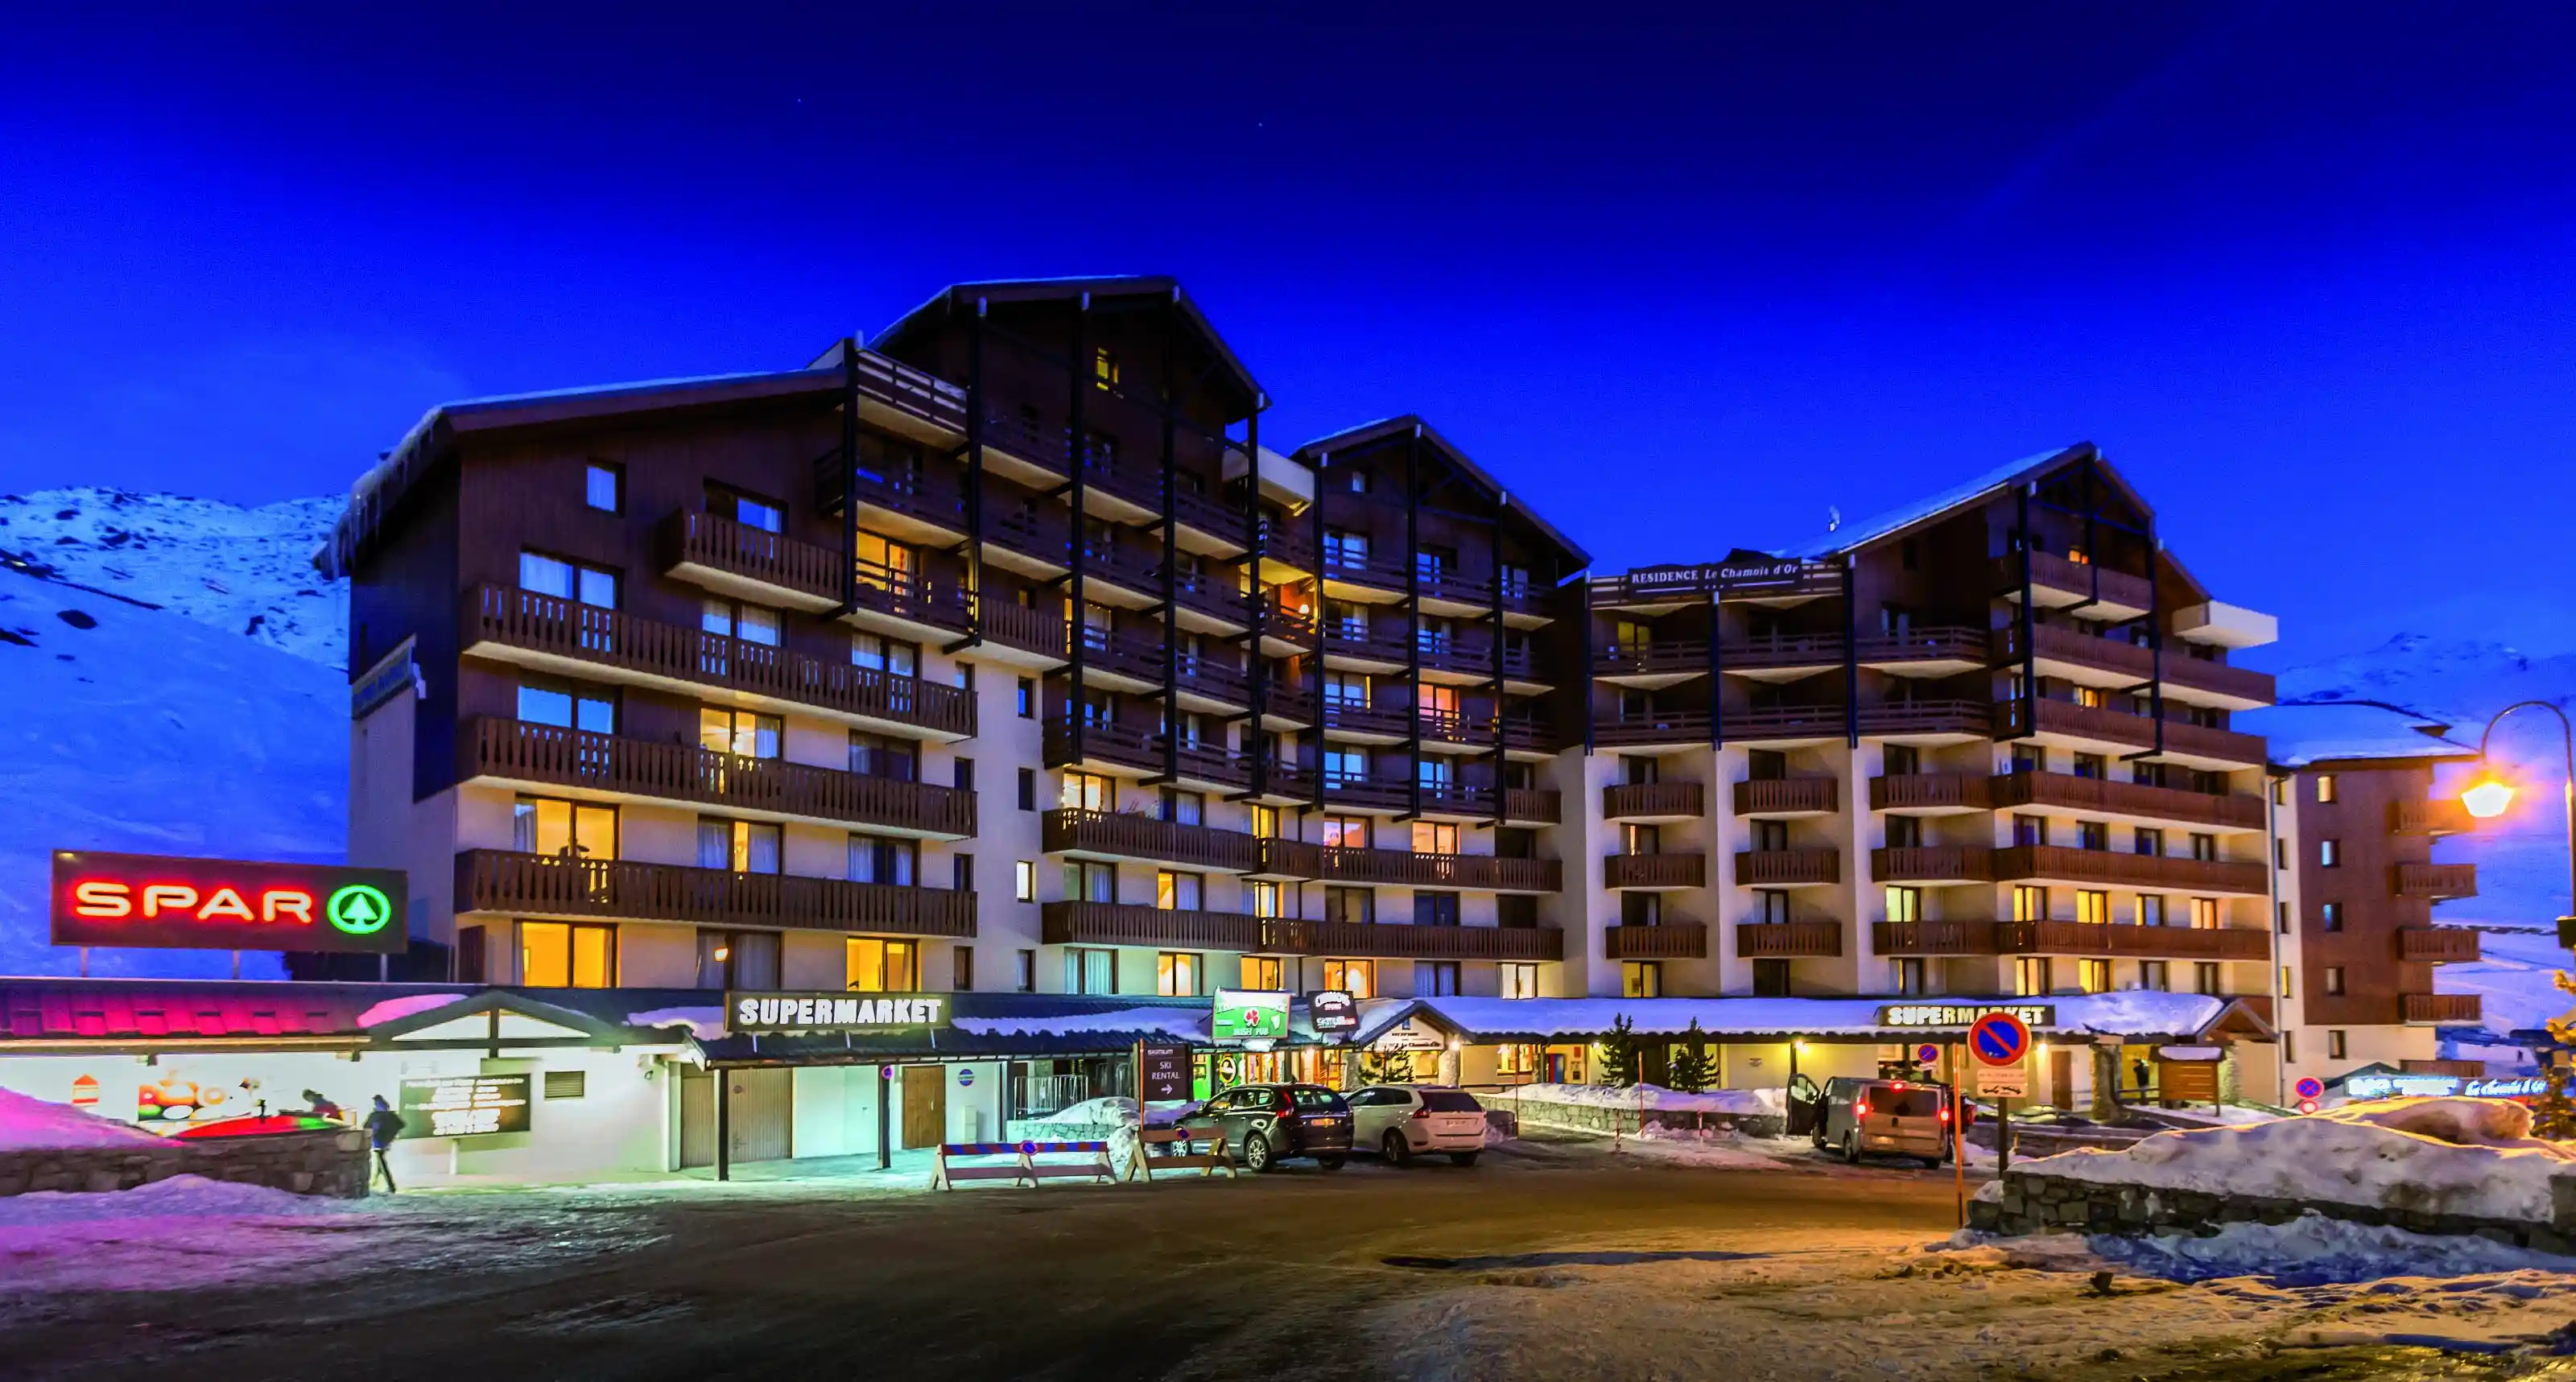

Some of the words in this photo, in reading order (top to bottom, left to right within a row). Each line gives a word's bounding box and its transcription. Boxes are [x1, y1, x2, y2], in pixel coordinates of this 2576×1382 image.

[1632, 569, 1699, 584] RESIDENCE
[1704, 568, 1718, 580] Le
[1721, 566, 1769, 579] Chamois
[1773, 563, 1798, 575] d'Or
[76, 881, 312, 923] SPAR
[739, 997, 943, 1025] SUPERMARKET
[1151, 1071, 1181, 1080] RENTAL
[1159, 1062, 1172, 1070] SKI
